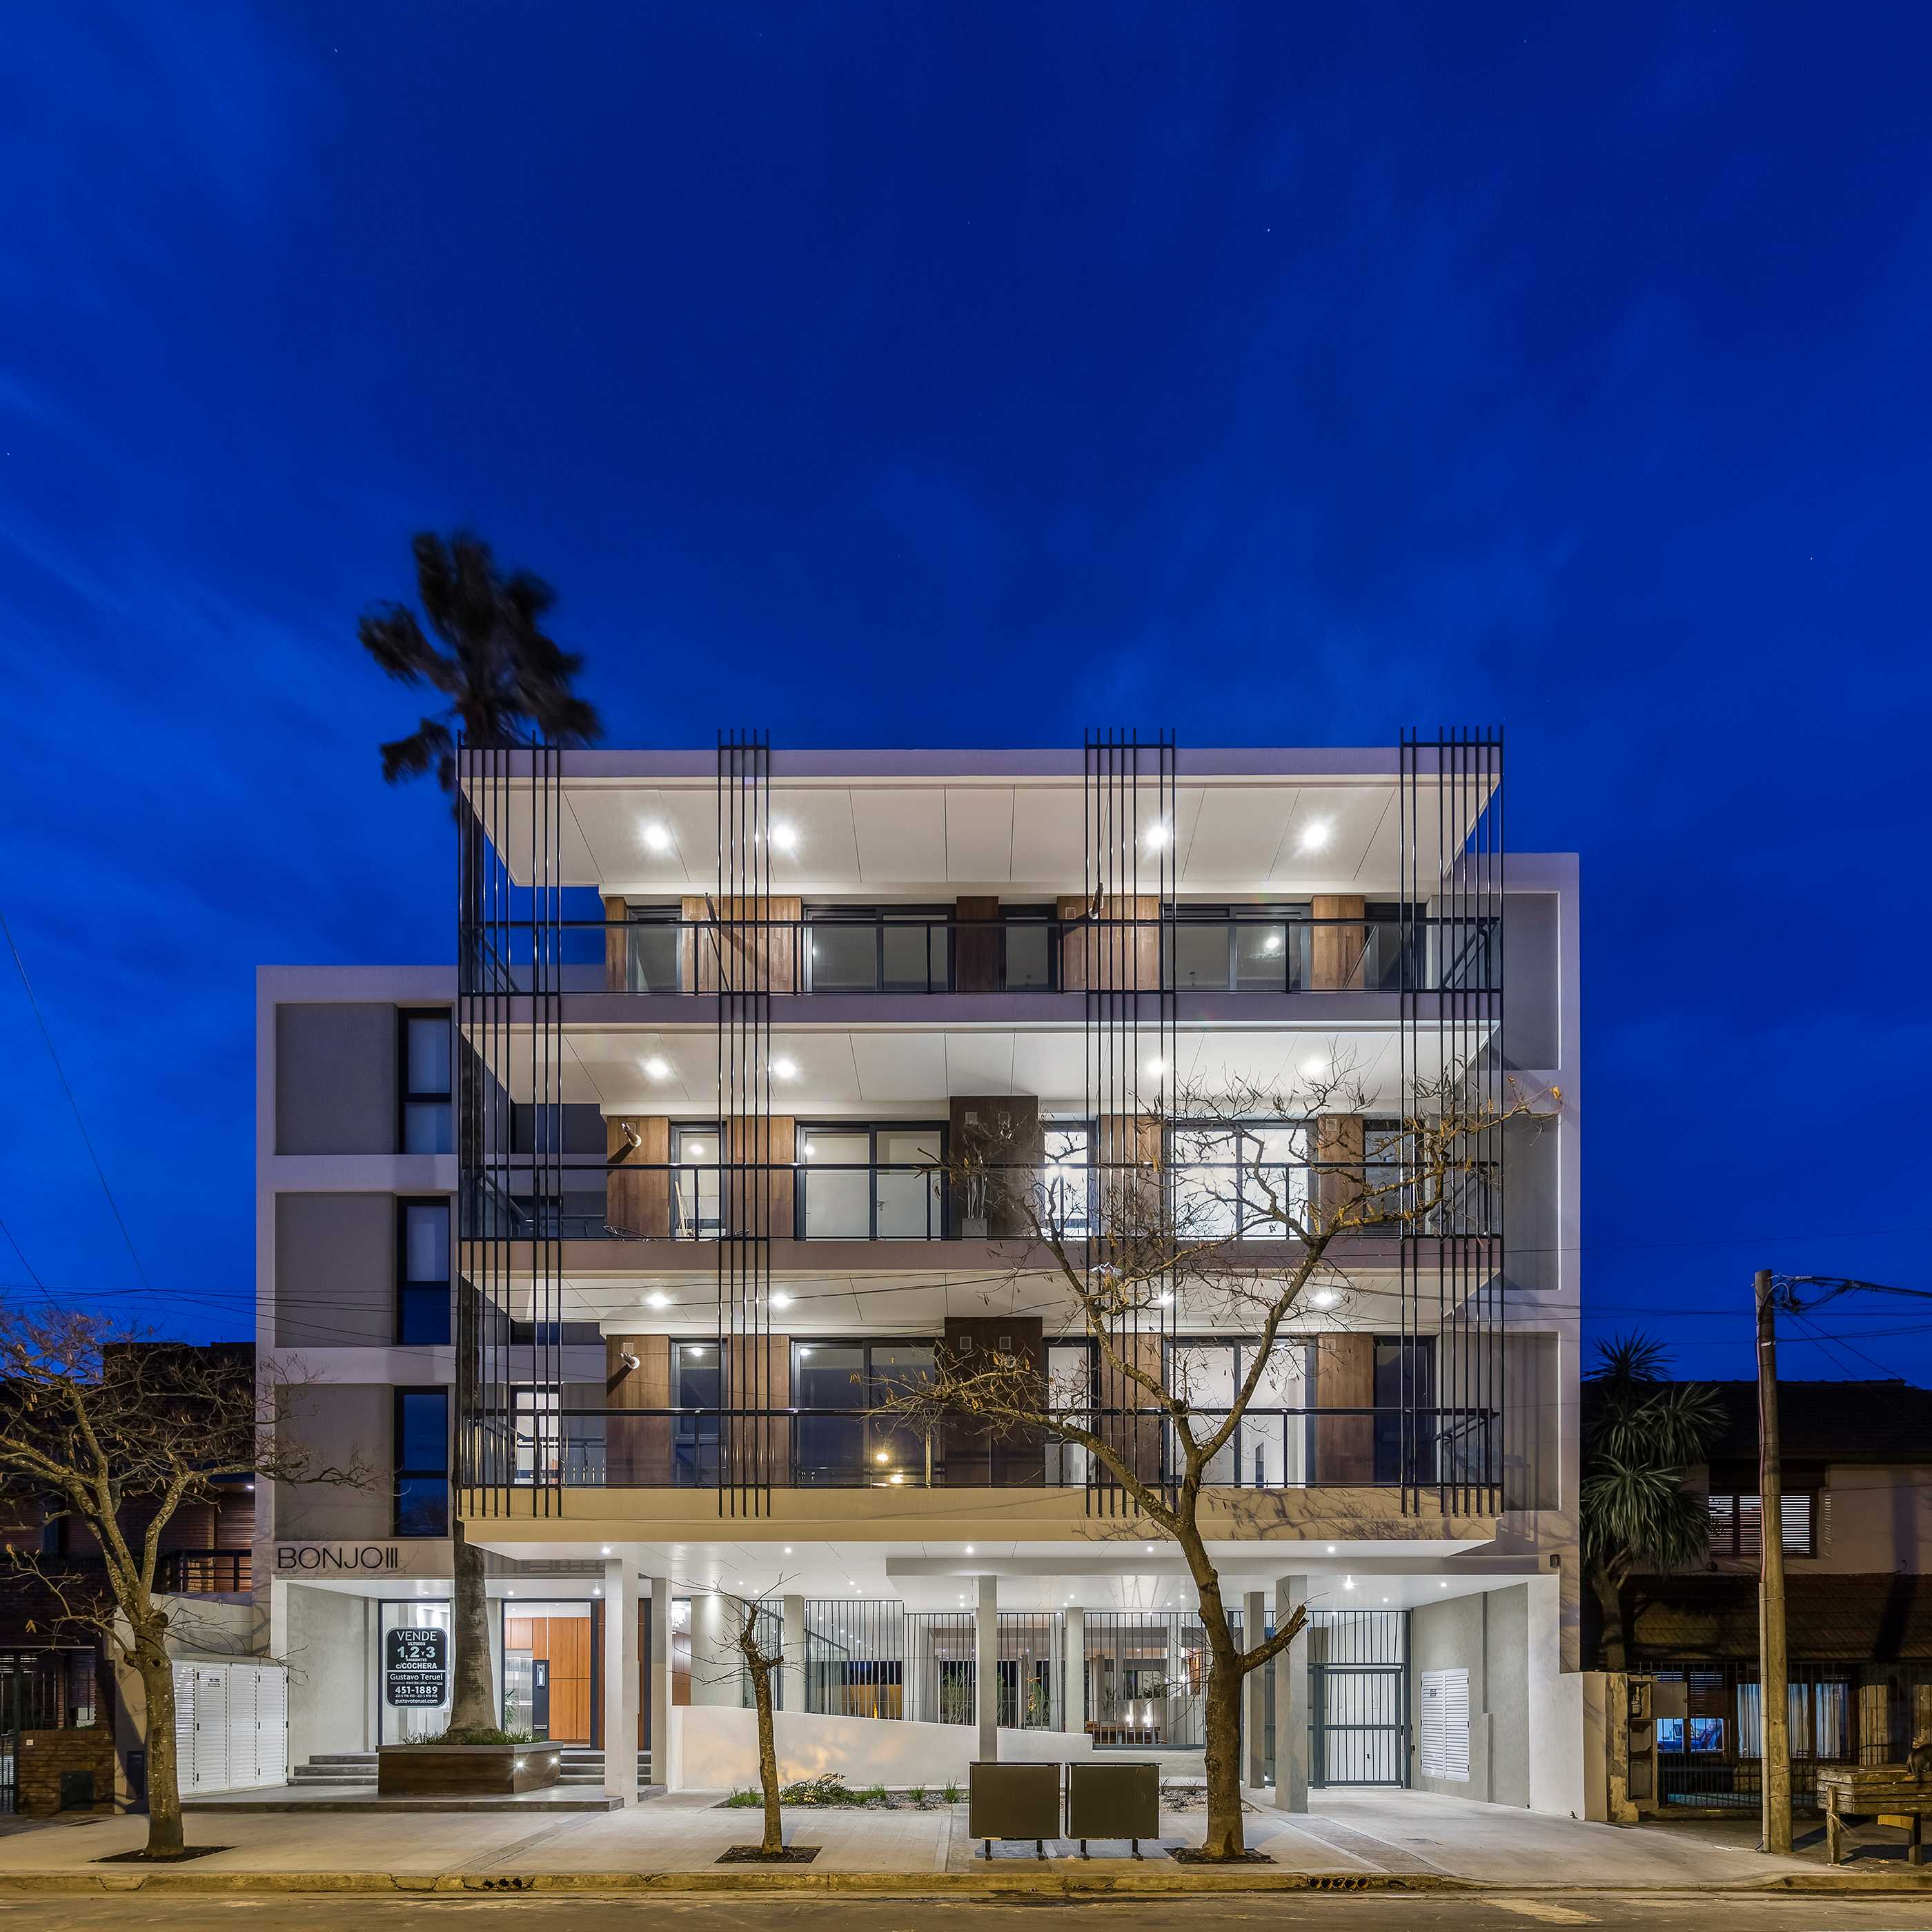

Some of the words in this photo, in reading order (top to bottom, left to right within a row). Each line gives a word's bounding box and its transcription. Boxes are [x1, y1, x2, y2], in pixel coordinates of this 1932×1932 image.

[397, 1630, 437, 1641] VENDE
[426, 1646, 435, 1658] 3
[395, 1686, 438, 1694] 451-1889
